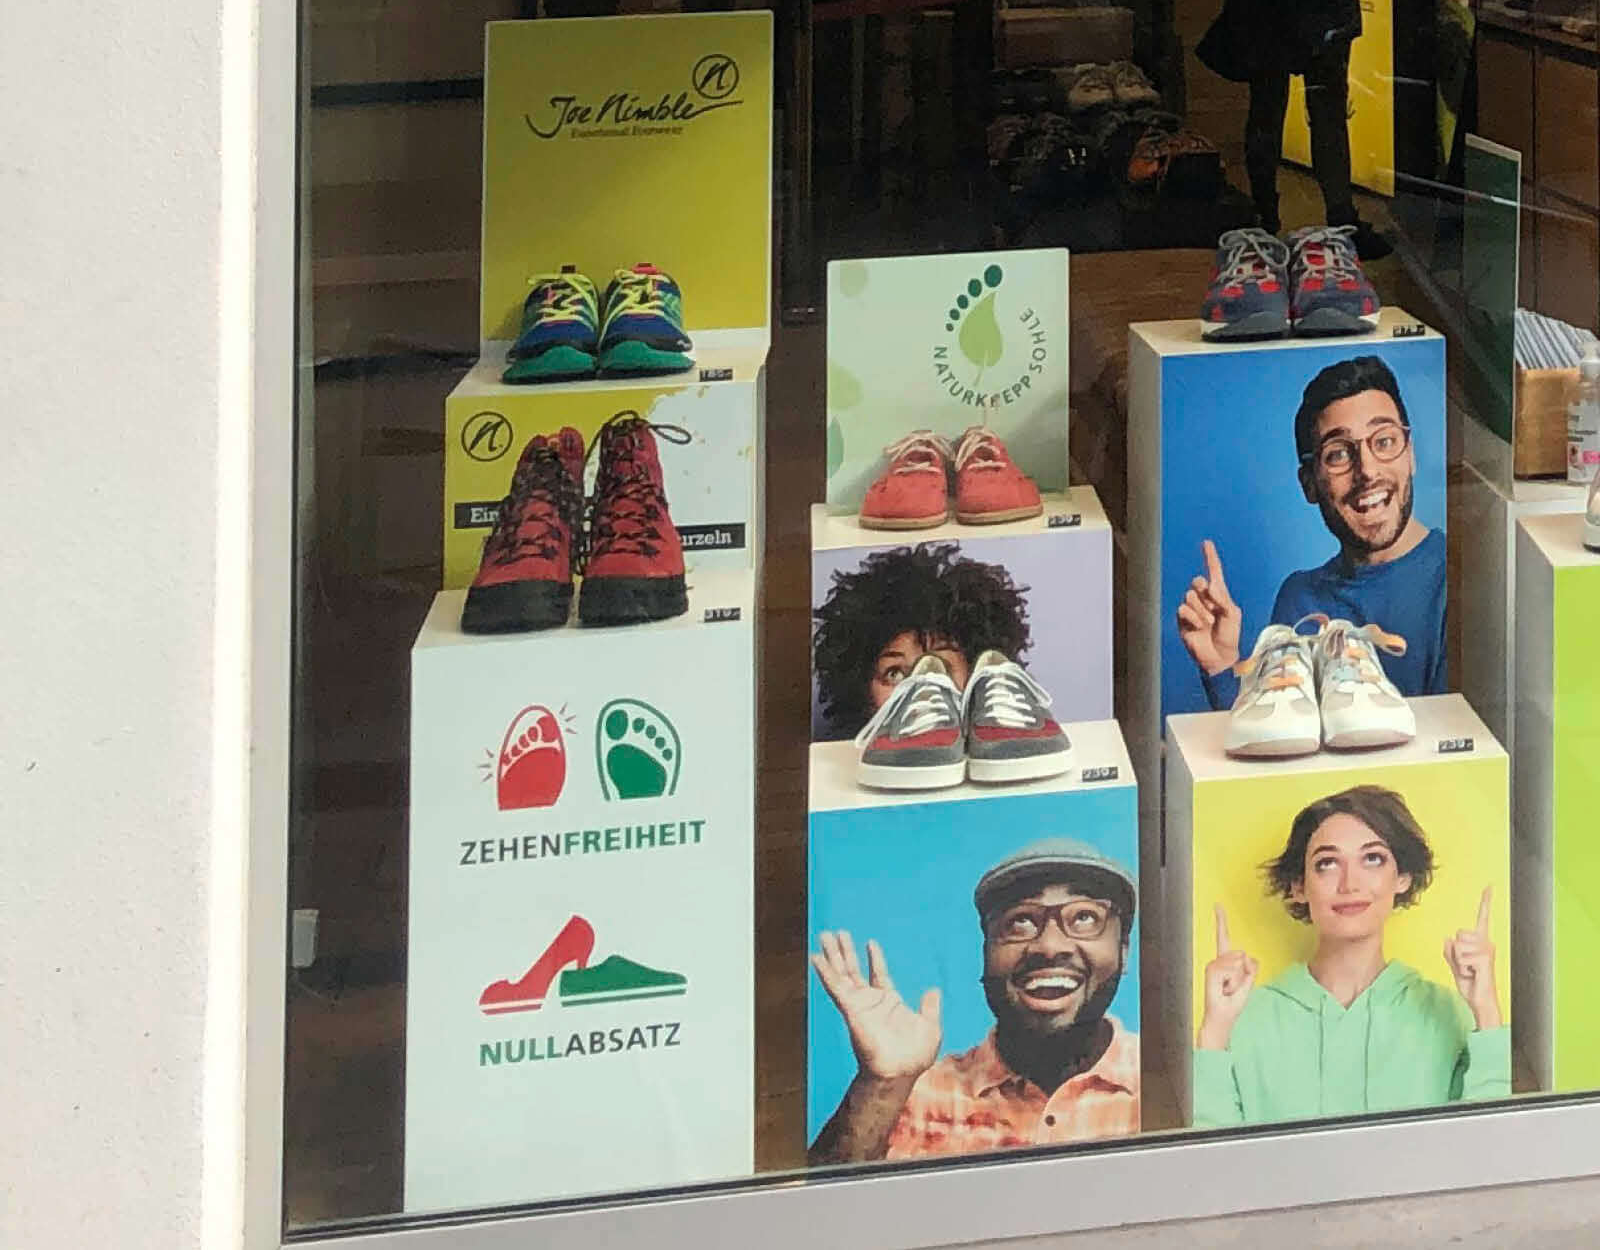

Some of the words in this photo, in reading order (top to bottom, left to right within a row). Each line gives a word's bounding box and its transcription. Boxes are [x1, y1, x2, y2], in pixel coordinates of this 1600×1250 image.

[526, 95, 592, 139] Joe
[596, 91, 744, 124] Nimble
[1019, 307, 1047, 375] SOHLE
[459, 819, 706, 866] ZEHENFREIHEIT
[479, 1022, 681, 1067] NULLABSATZ
